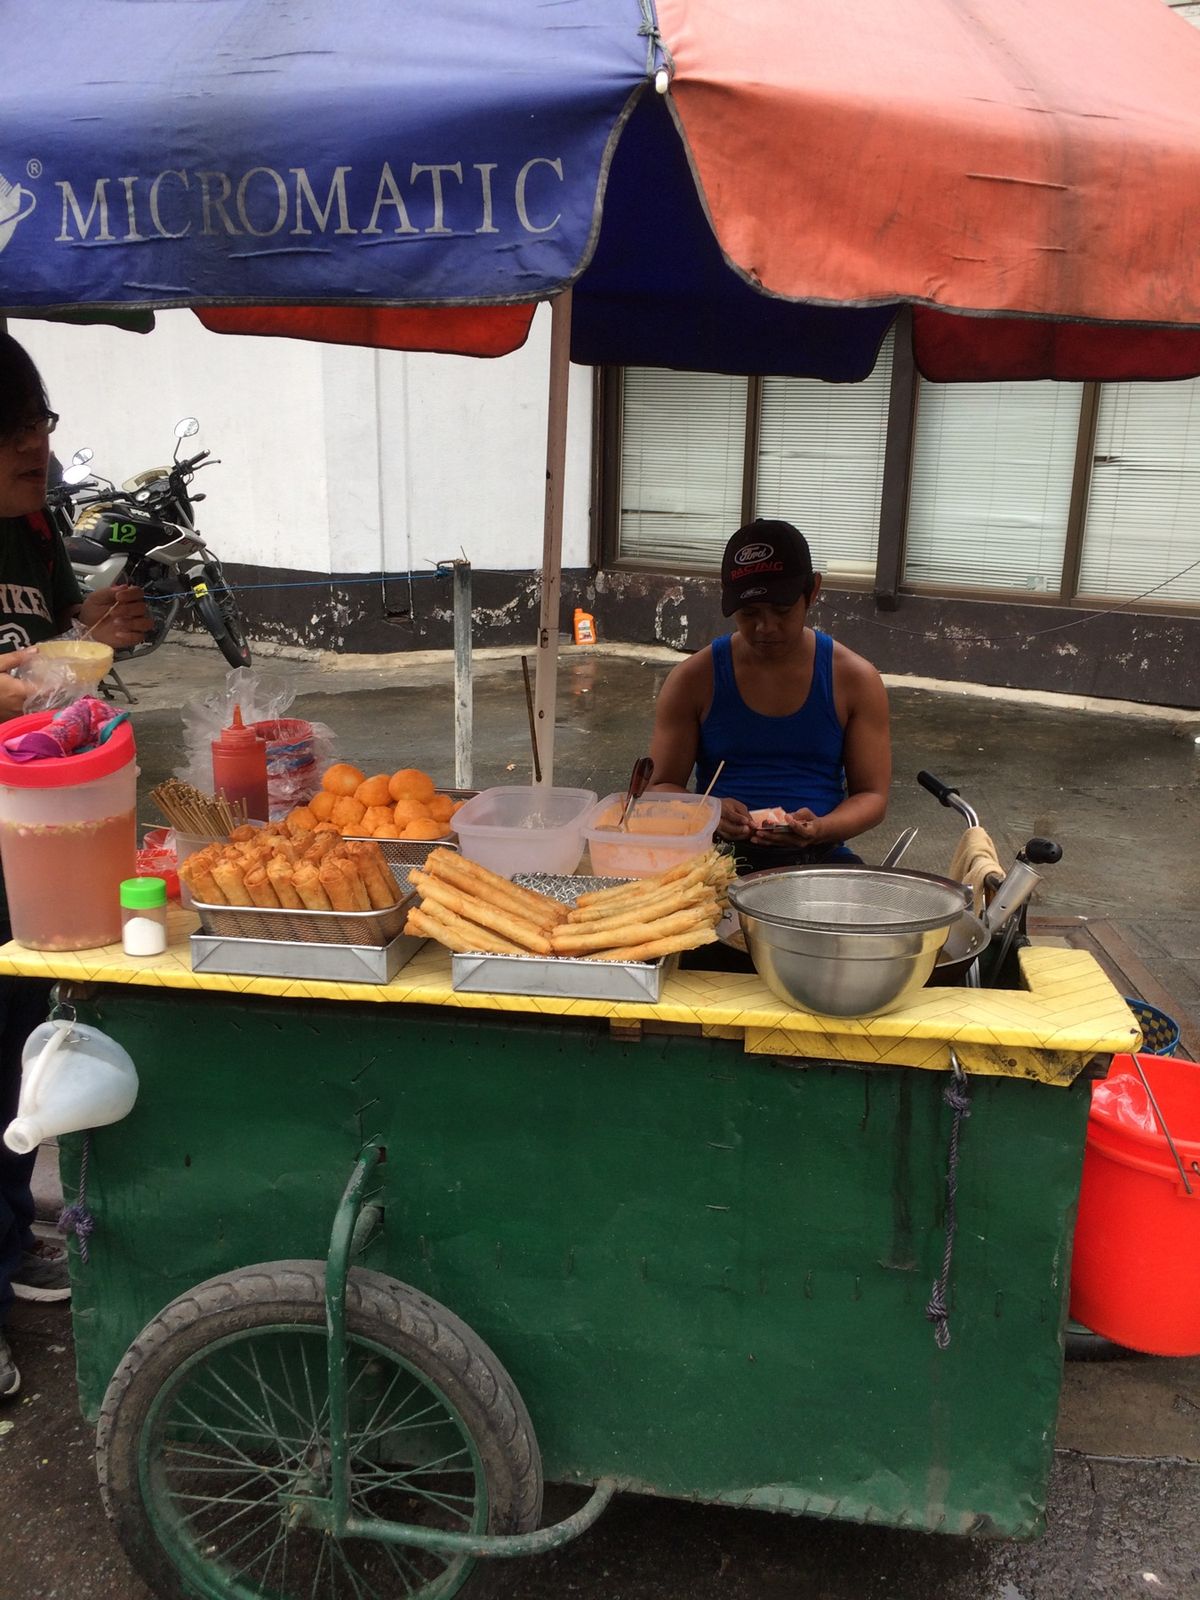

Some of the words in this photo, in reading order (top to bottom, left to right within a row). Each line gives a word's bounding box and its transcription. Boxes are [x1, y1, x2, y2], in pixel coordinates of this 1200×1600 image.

[55, 157, 565, 242] MICROMATIC
[108, 522, 137, 544] 12
[739, 546, 767, 562] Ford
[731, 561, 785, 581] RACING
